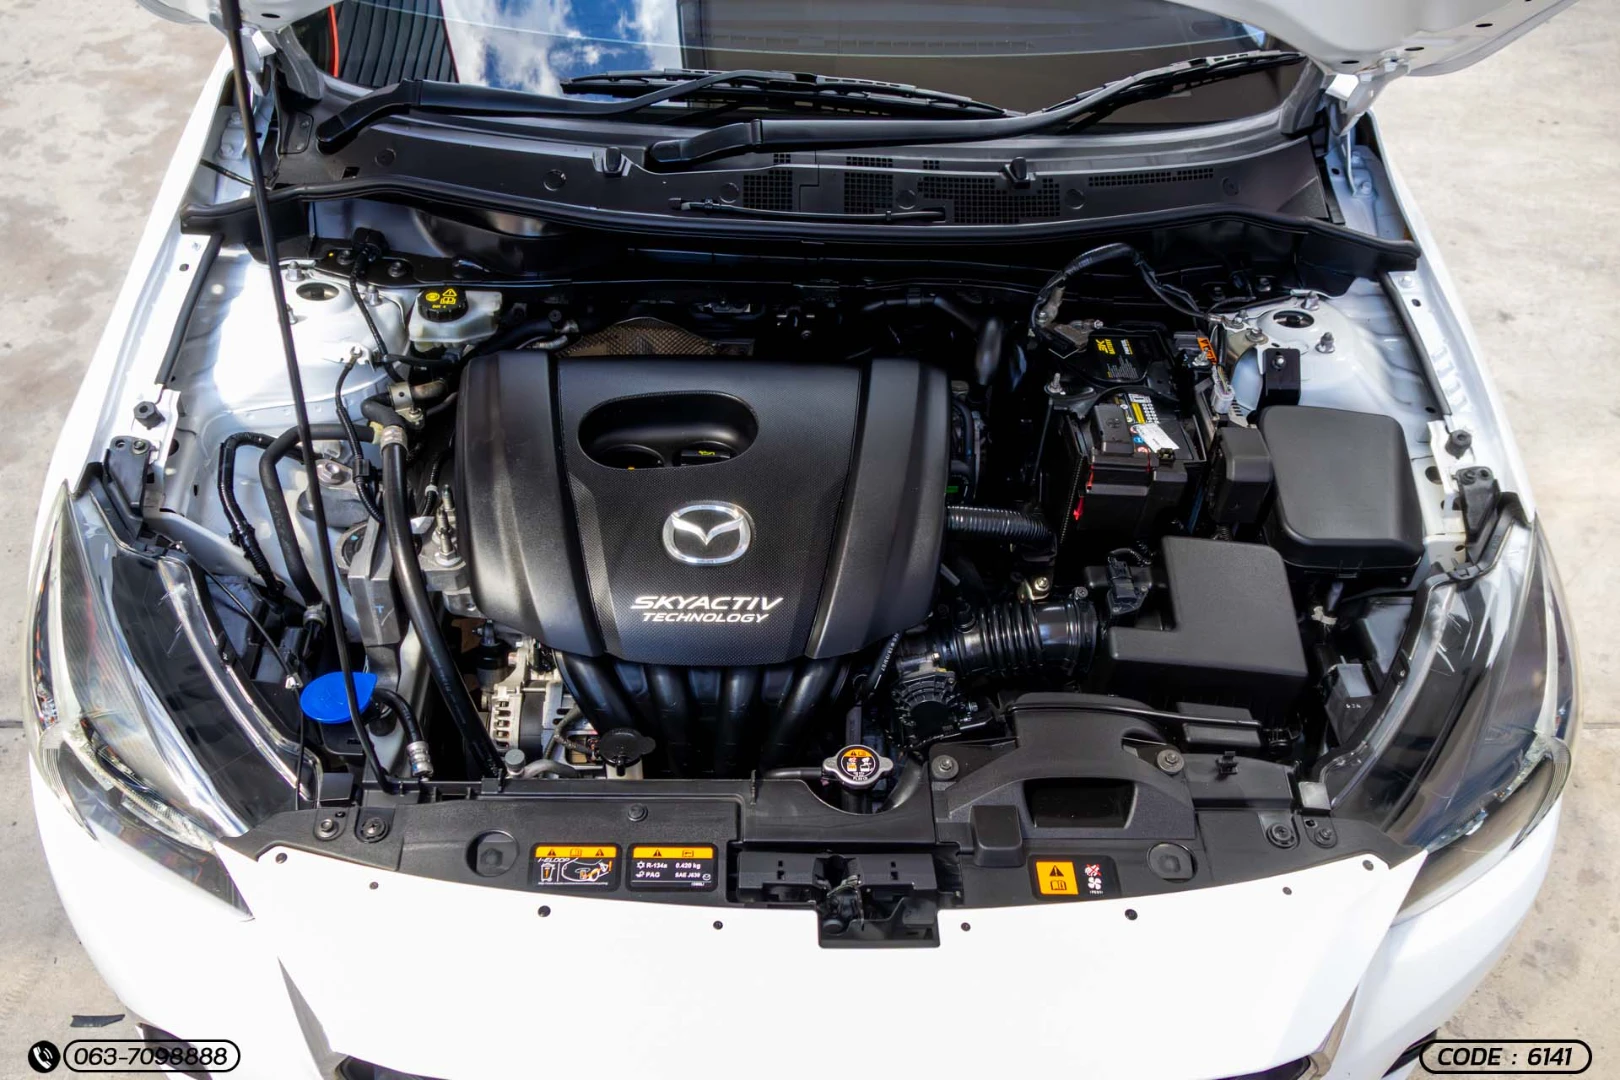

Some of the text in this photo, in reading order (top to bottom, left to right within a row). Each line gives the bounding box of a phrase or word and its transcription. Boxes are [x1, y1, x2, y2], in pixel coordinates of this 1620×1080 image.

[630, 595, 784, 610] SKYACTIV
[642, 613, 769, 623] TECHNOLOGY
[692, 862, 701, 870] kg
